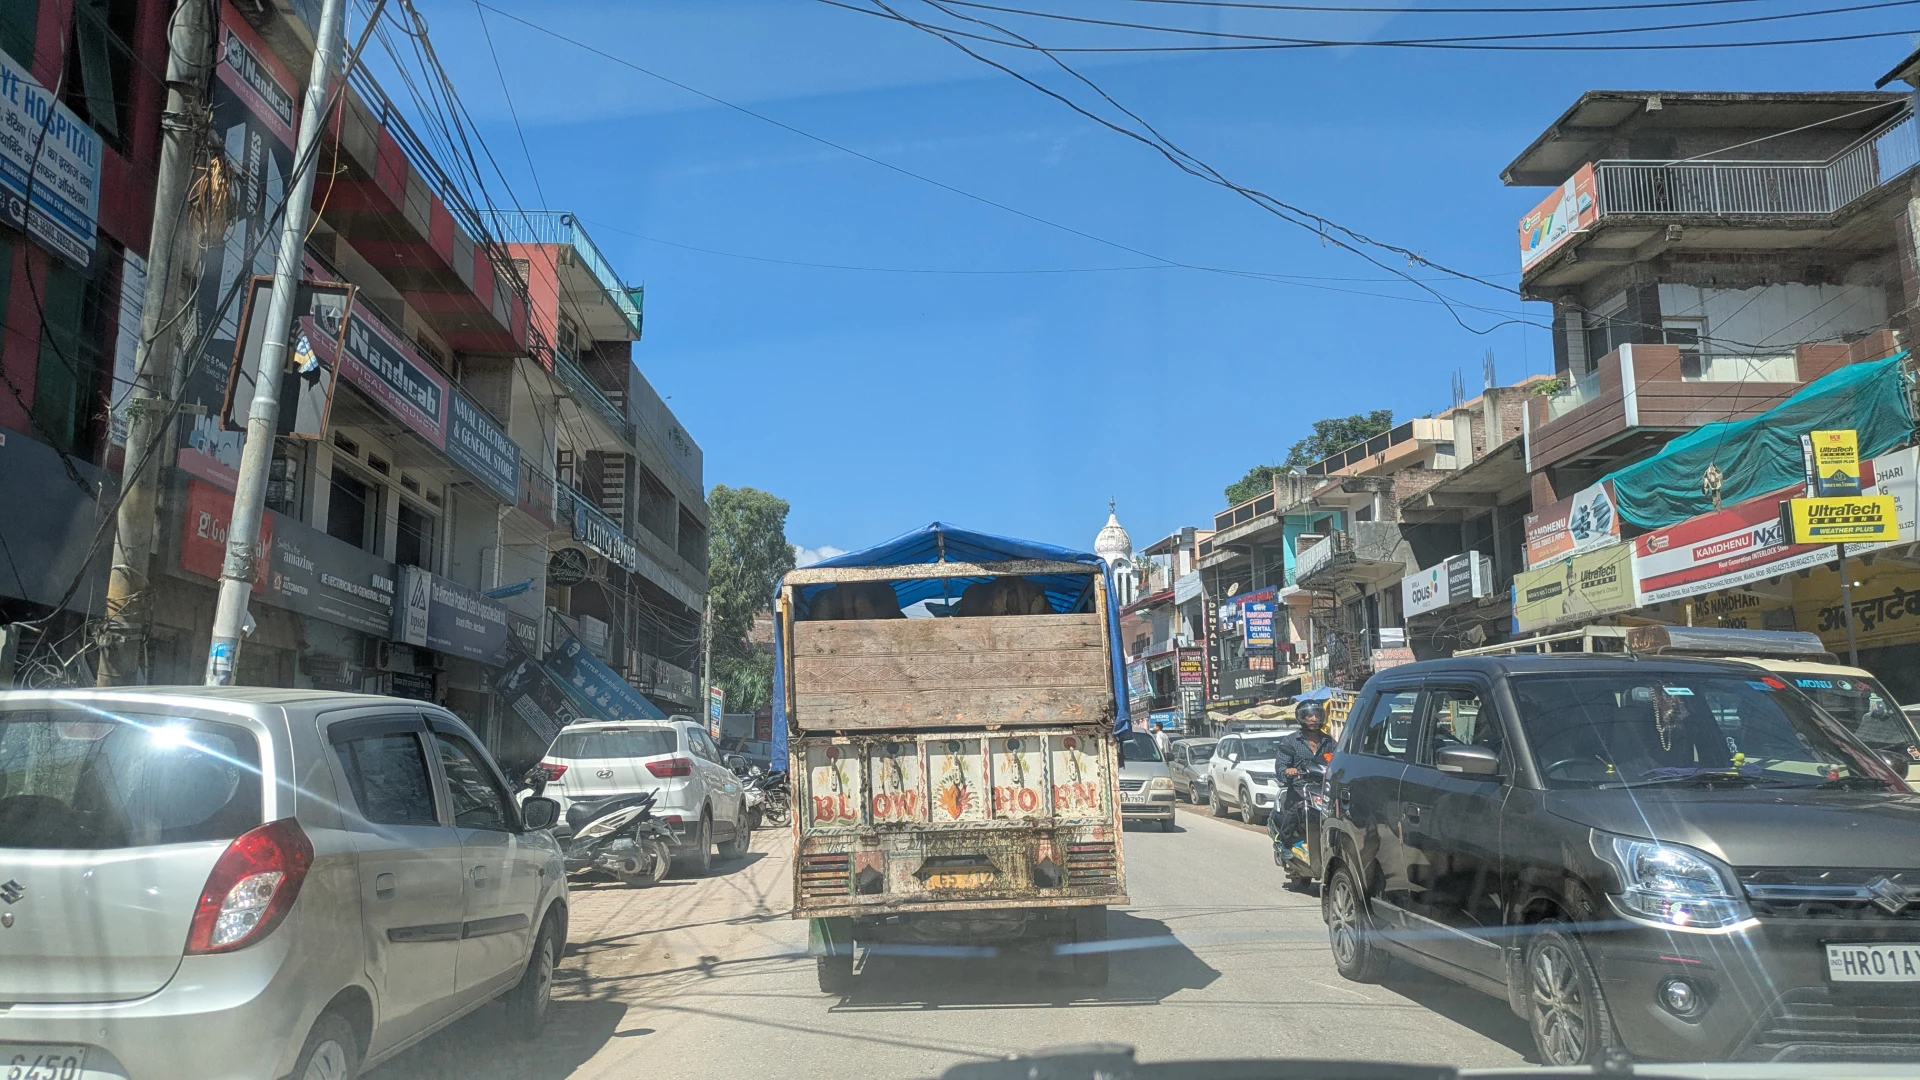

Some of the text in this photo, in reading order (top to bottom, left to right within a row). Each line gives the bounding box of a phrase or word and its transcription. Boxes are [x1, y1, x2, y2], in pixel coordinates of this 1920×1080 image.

[245, 55, 290, 121] Nandicab
[24, 85, 95, 170] HOSPITAL
[350, 318, 436, 415] Nandicab
[312, 331, 386, 395] ELETRICAL
[388, 391, 440, 436] PRODUCTS
[454, 396, 477, 430] NAVAL
[478, 417, 515, 463] ELECTRICAL
[453, 420, 460, 439] &
[461, 427, 492, 465] GENERAL
[493, 453, 514, 482] STORE
[1808, 503, 1880, 517] UltraTech
[1812, 516, 1879, 524] CEMENT
[1529, 517, 1566, 540] KAMDHENU
[1819, 527, 1854, 535] WEATHER
[1696, 536, 1749, 558] KAMDHENU
[1728, 556, 1752, 567] Generation
[1752, 547, 1777, 561] INTERLOCK
[1449, 571, 1471, 585] HARDWARE
[1580, 563, 1616, 582] UltraTech
[1412, 585, 1430, 605] opus
[516, 621, 536, 641] LOOKS
[1208, 602, 1220, 700] DENTAL CLINIC
[580, 658, 598, 675] BETTER
[598, 672, 620, 693] HEARING
[624, 694, 642, 712] BETTER
[1796, 679, 1832, 688] MONU
